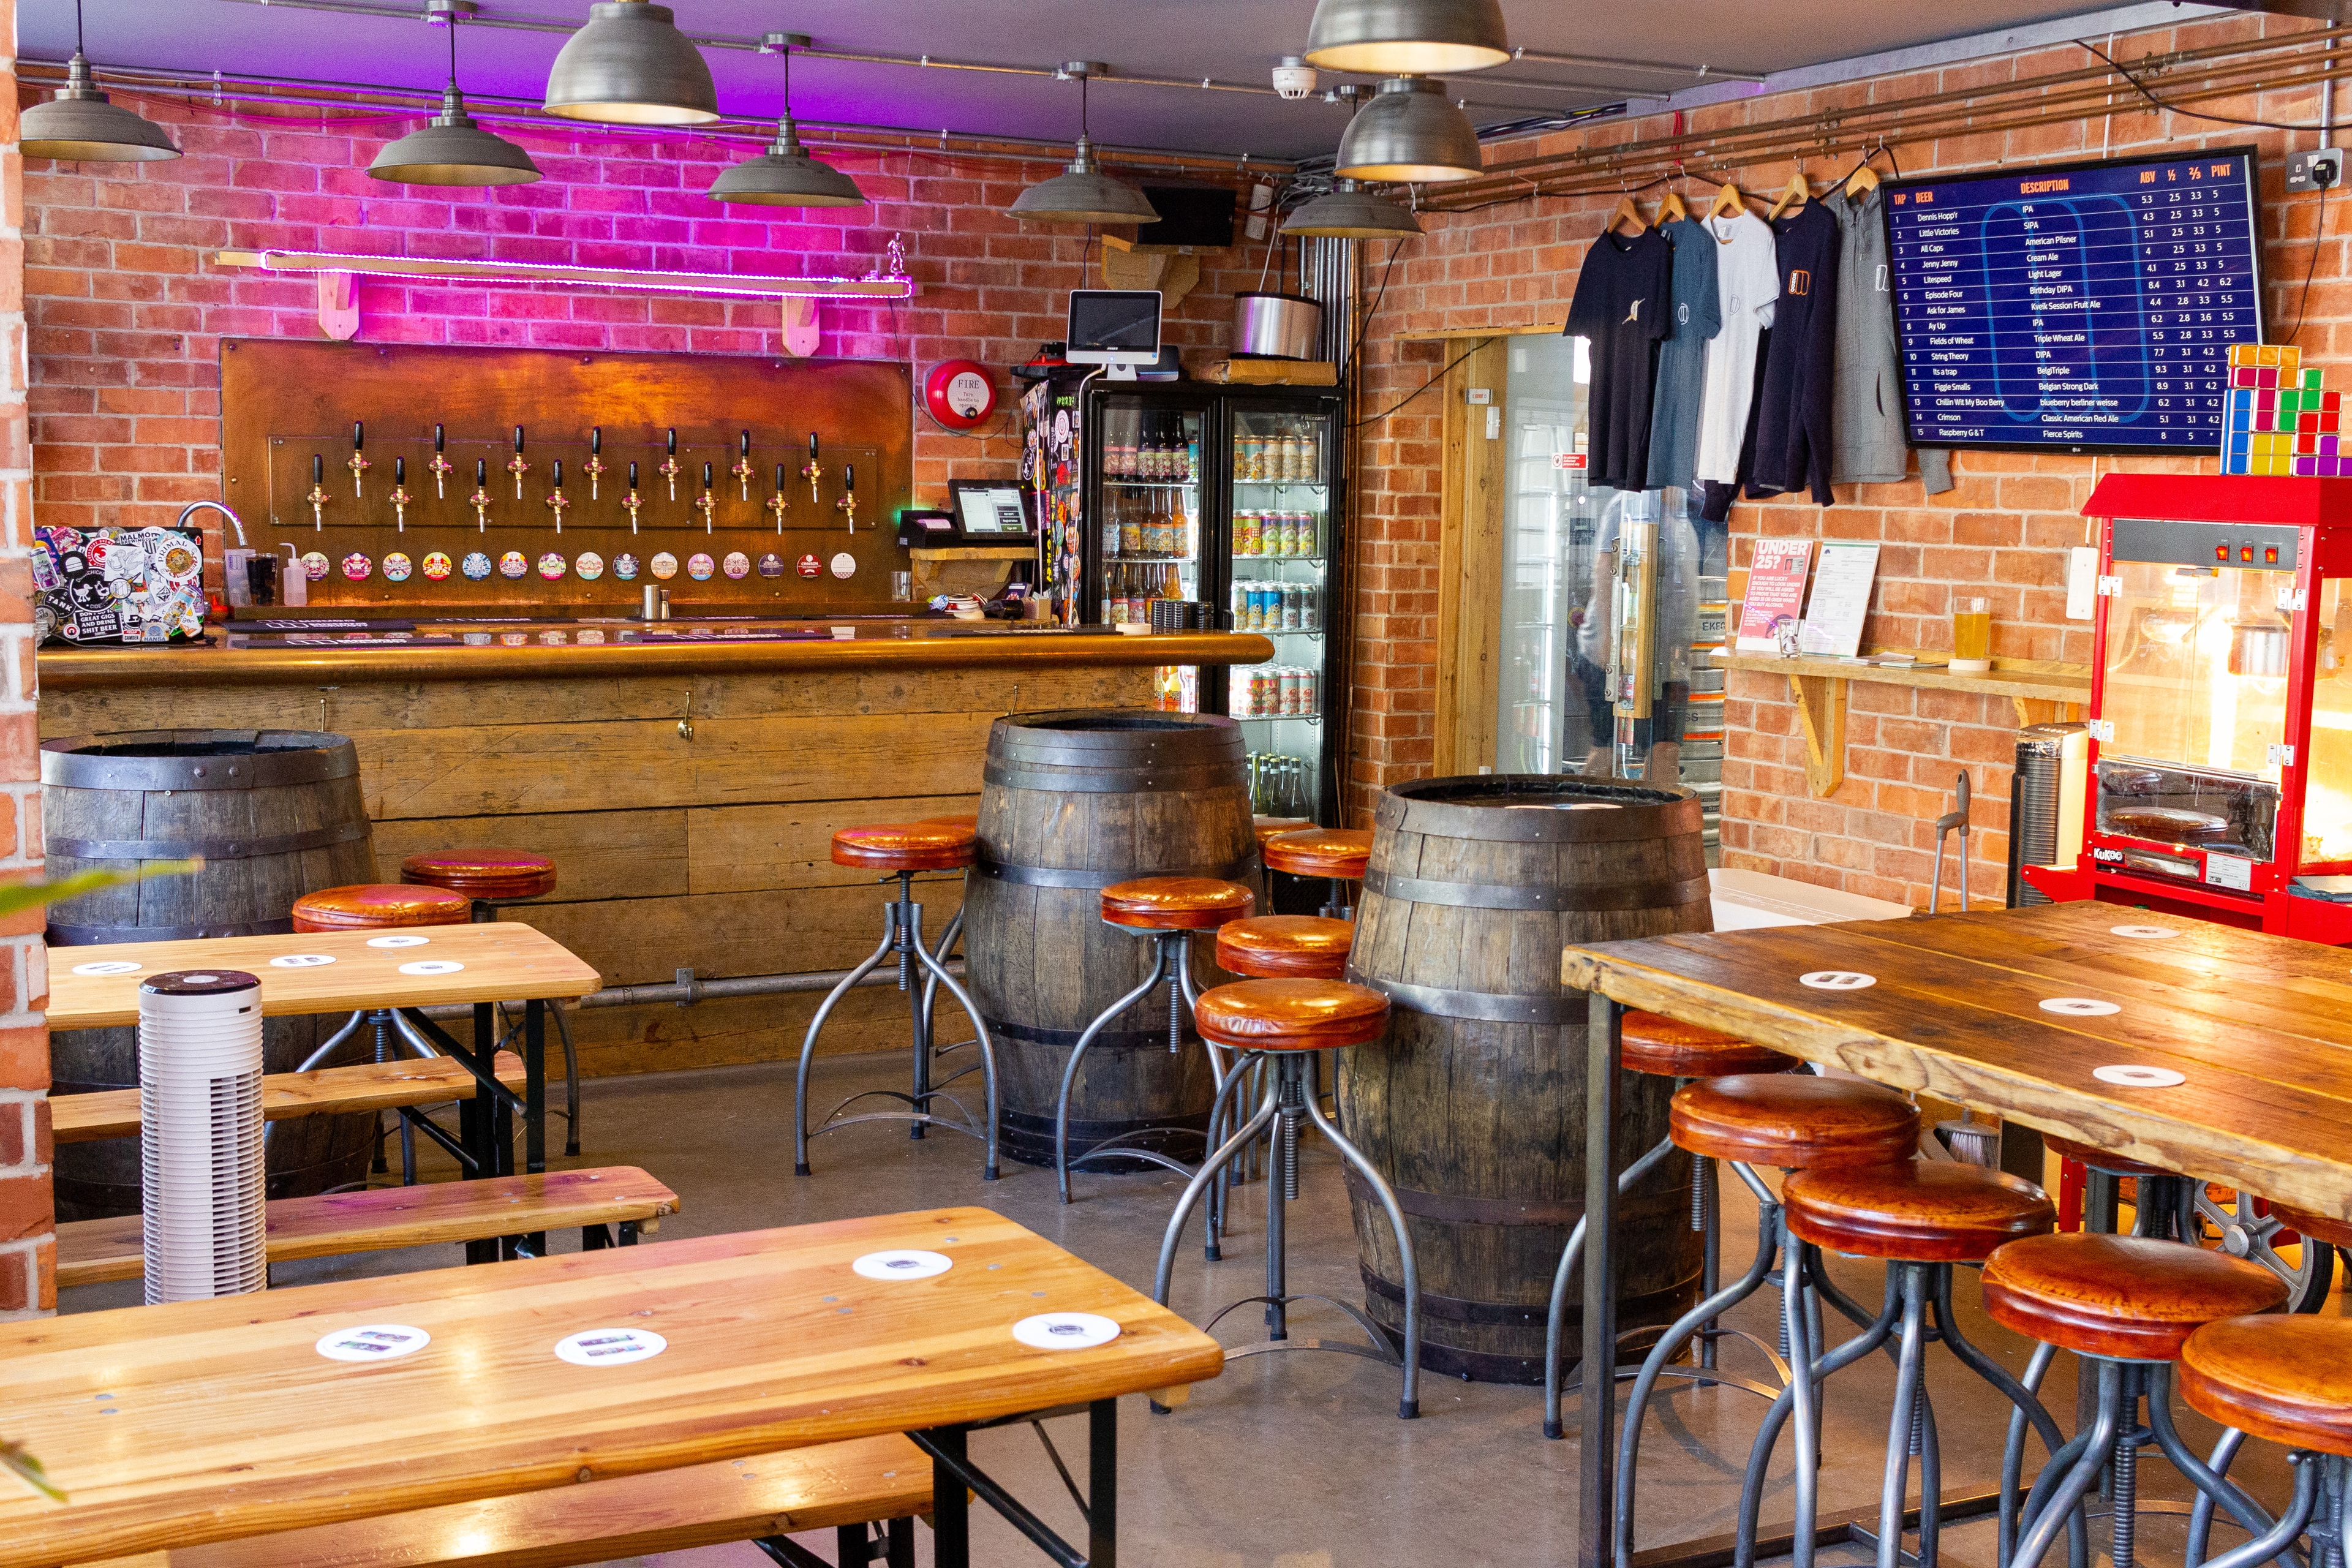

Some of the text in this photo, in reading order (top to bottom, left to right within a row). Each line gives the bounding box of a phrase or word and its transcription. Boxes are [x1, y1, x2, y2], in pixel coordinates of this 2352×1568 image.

[1893, 194, 1907, 205] TAP
[1915, 190, 1934, 203] BEER
[2020, 178, 2070, 194] DESCRIPTION
[2139, 170, 2156, 184] ABV
[2211, 164, 2231, 178] PINT
[1917, 213, 1938, 222] Dennis
[2141, 195, 2153, 204] 5.3
[1919, 229, 1934, 238] Little
[2023, 221, 2039, 230] SIPA
[2143, 212, 2154, 221] 4.3
[1928, 244, 1944, 253] Caps
[2025, 237, 2055, 246] American
[2055, 235, 2077, 244] Pilsner
[2144, 230, 2154, 238] 5.1
[2048, 252, 2059, 261] Ale
[1923, 275, 1952, 284] Litespeed
[2028, 270, 2045, 280] Light
[2044, 270, 2062, 279] Lager
[1925, 281, 2160, 300] Episode Four Birthday DIPA 8.4
[1937, 306, 1947, 314] for
[2030, 302, 2048, 311] Kveik
[2048, 301, 2073, 310] Session
[1928, 322, 1937, 331] Ay
[1936, 322, 1947, 331] Up
[1947, 336, 1954, 345] of
[2034, 334, 2052, 344] Triple
[2052, 334, 2074, 342] Wheat
[2074, 333, 2086, 342] Ale
[1931, 350, 2051, 361] String Theory DIPA
[959, 380, 979, 388] FIRE
[2038, 382, 2062, 392] Belgian
[2061, 382, 2084, 392] Strong
[1964, 398, 1975, 407] My
[1988, 398, 2005, 407] Berry
[2040, 398, 2070, 408] blueberry
[1939, 428, 1968, 437] Raspberry
[2062, 430, 2083, 439] Spirits
[158, 540, 187, 562] PRIMAL
[1758, 541, 1807, 556] UNDER
[1755, 555, 1781, 570] 25?
[48, 595, 72, 611] TANK
